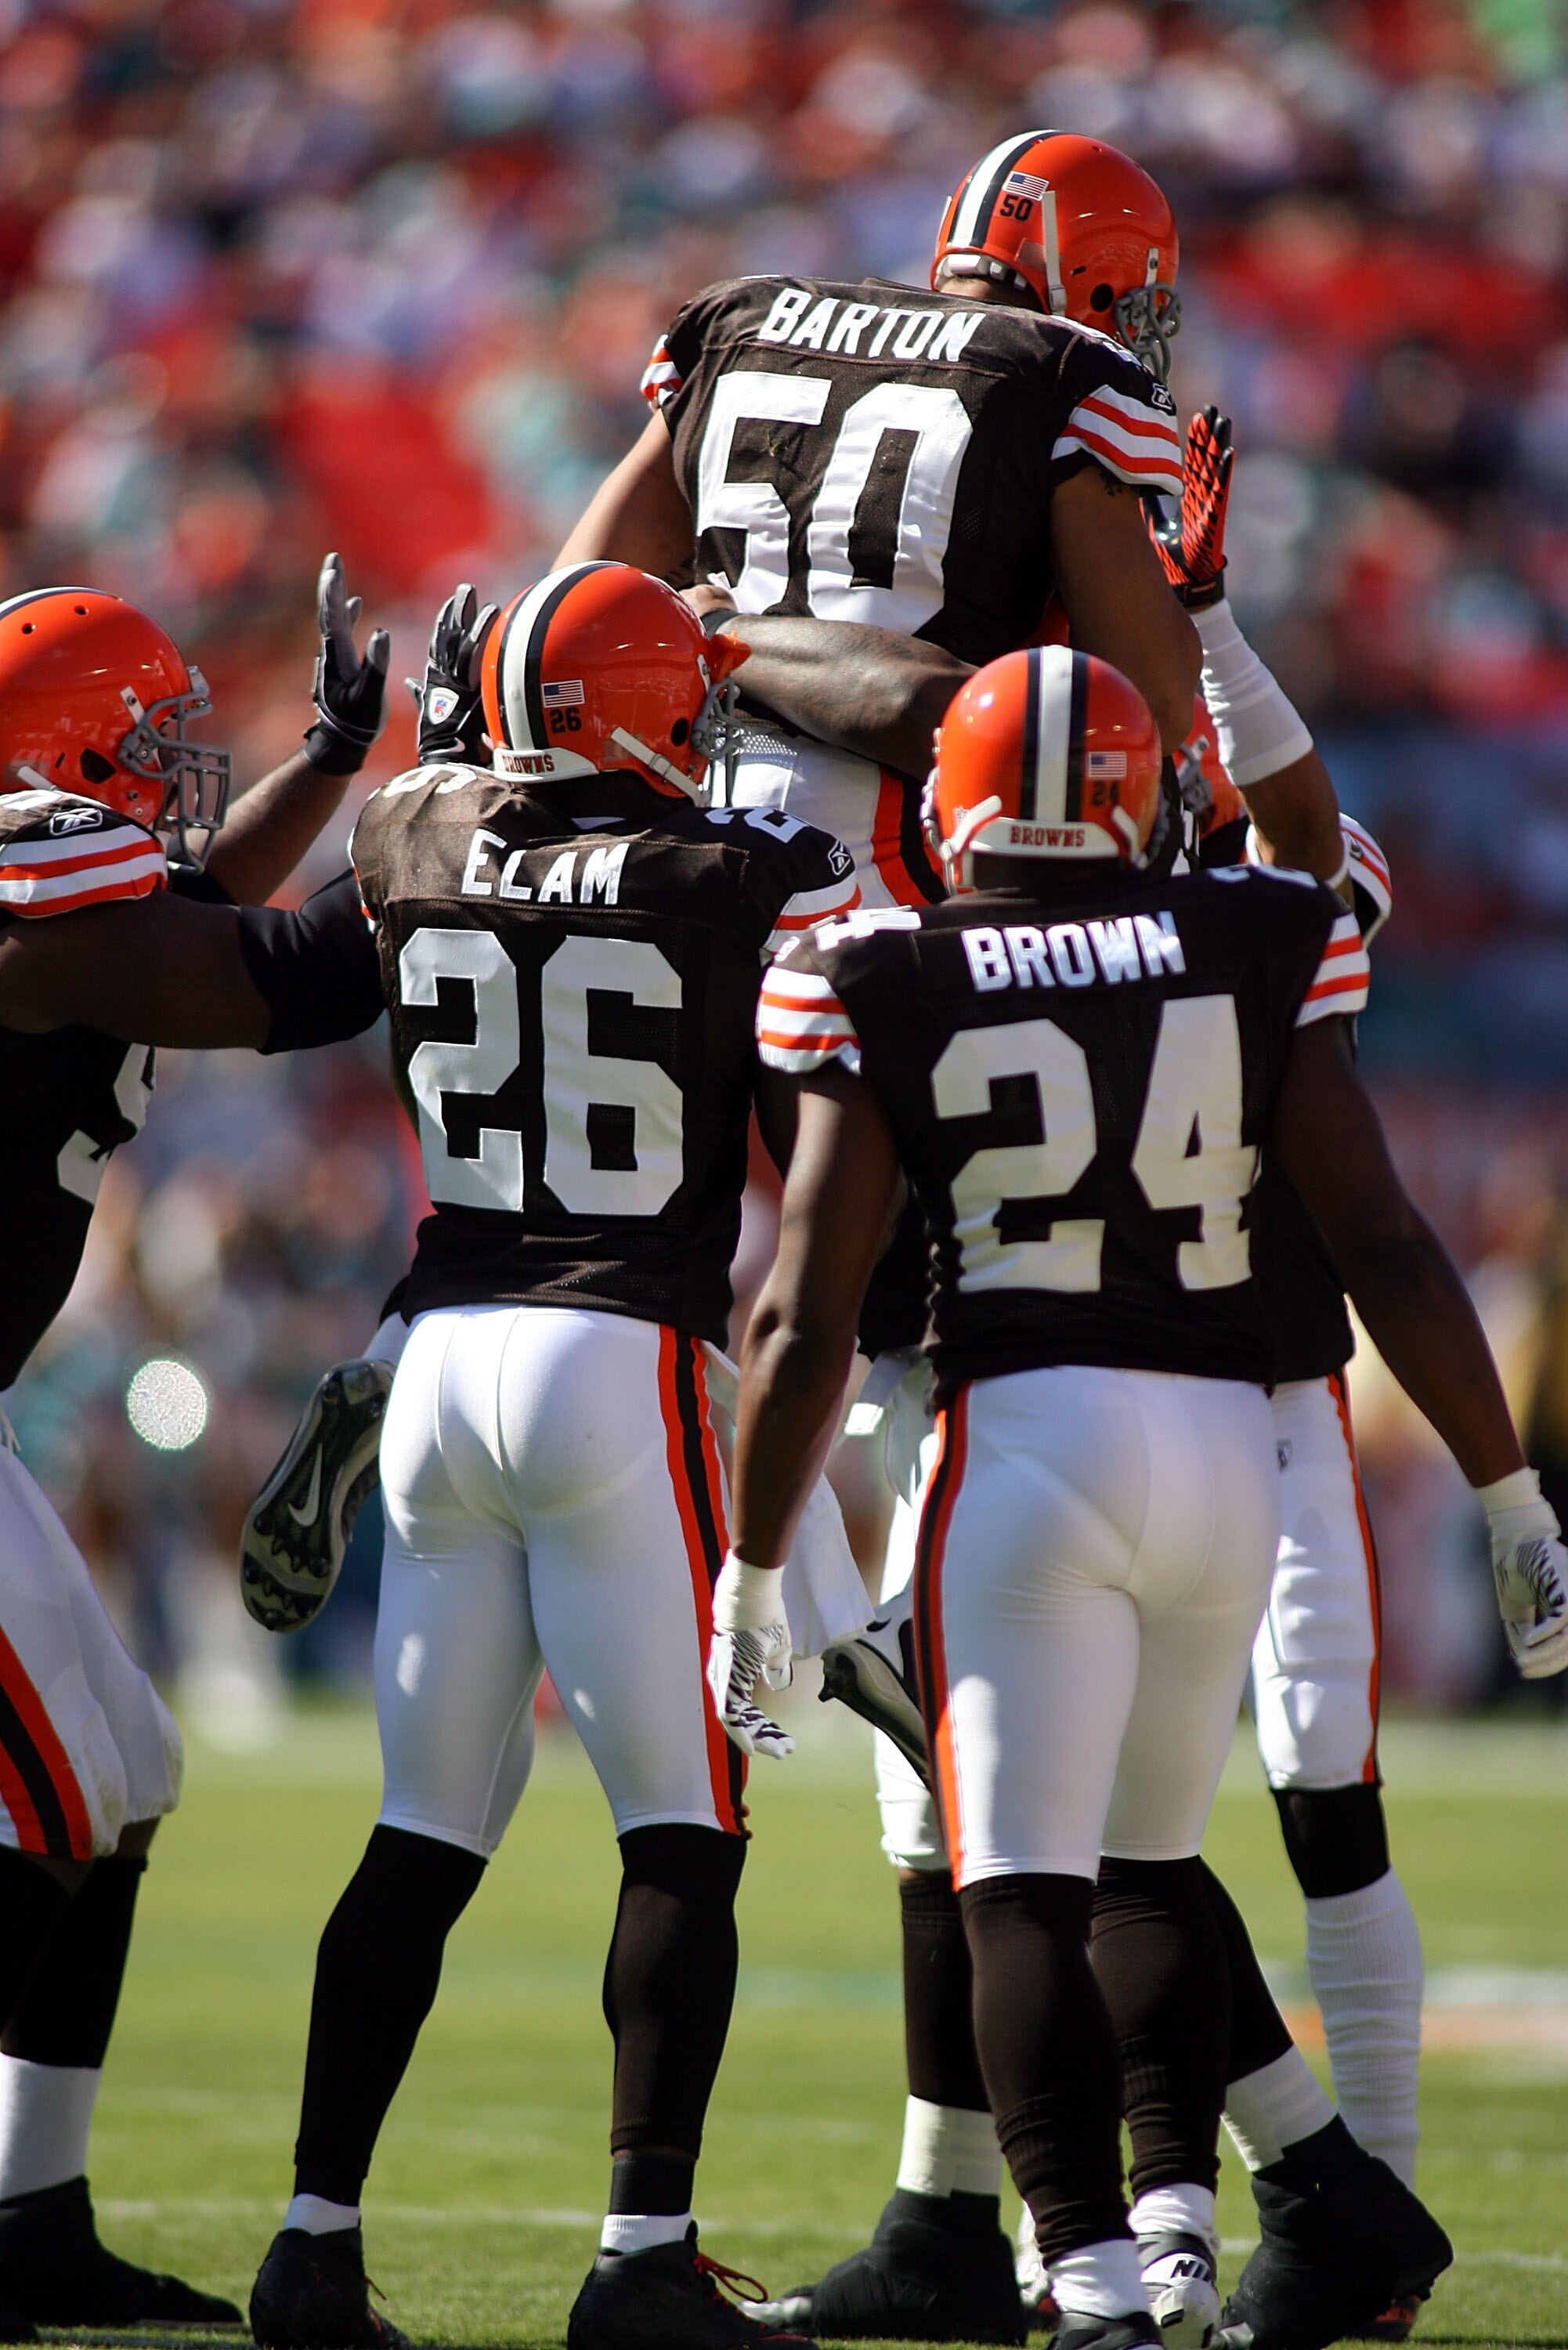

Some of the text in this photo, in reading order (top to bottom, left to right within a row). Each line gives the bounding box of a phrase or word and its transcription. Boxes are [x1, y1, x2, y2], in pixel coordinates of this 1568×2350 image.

[1000, 194, 1033, 221] 50
[757, 287, 986, 362] BARTON
[696, 371, 974, 637] 50
[550, 707, 582, 733] 26
[502, 754, 555, 773] BROWNS
[461, 828, 630, 905] ELAM
[1010, 825, 1085, 847] BROWNS
[960, 909, 1187, 992] BROWN
[399, 927, 683, 1216] 26
[930, 993, 1262, 1292] 24
